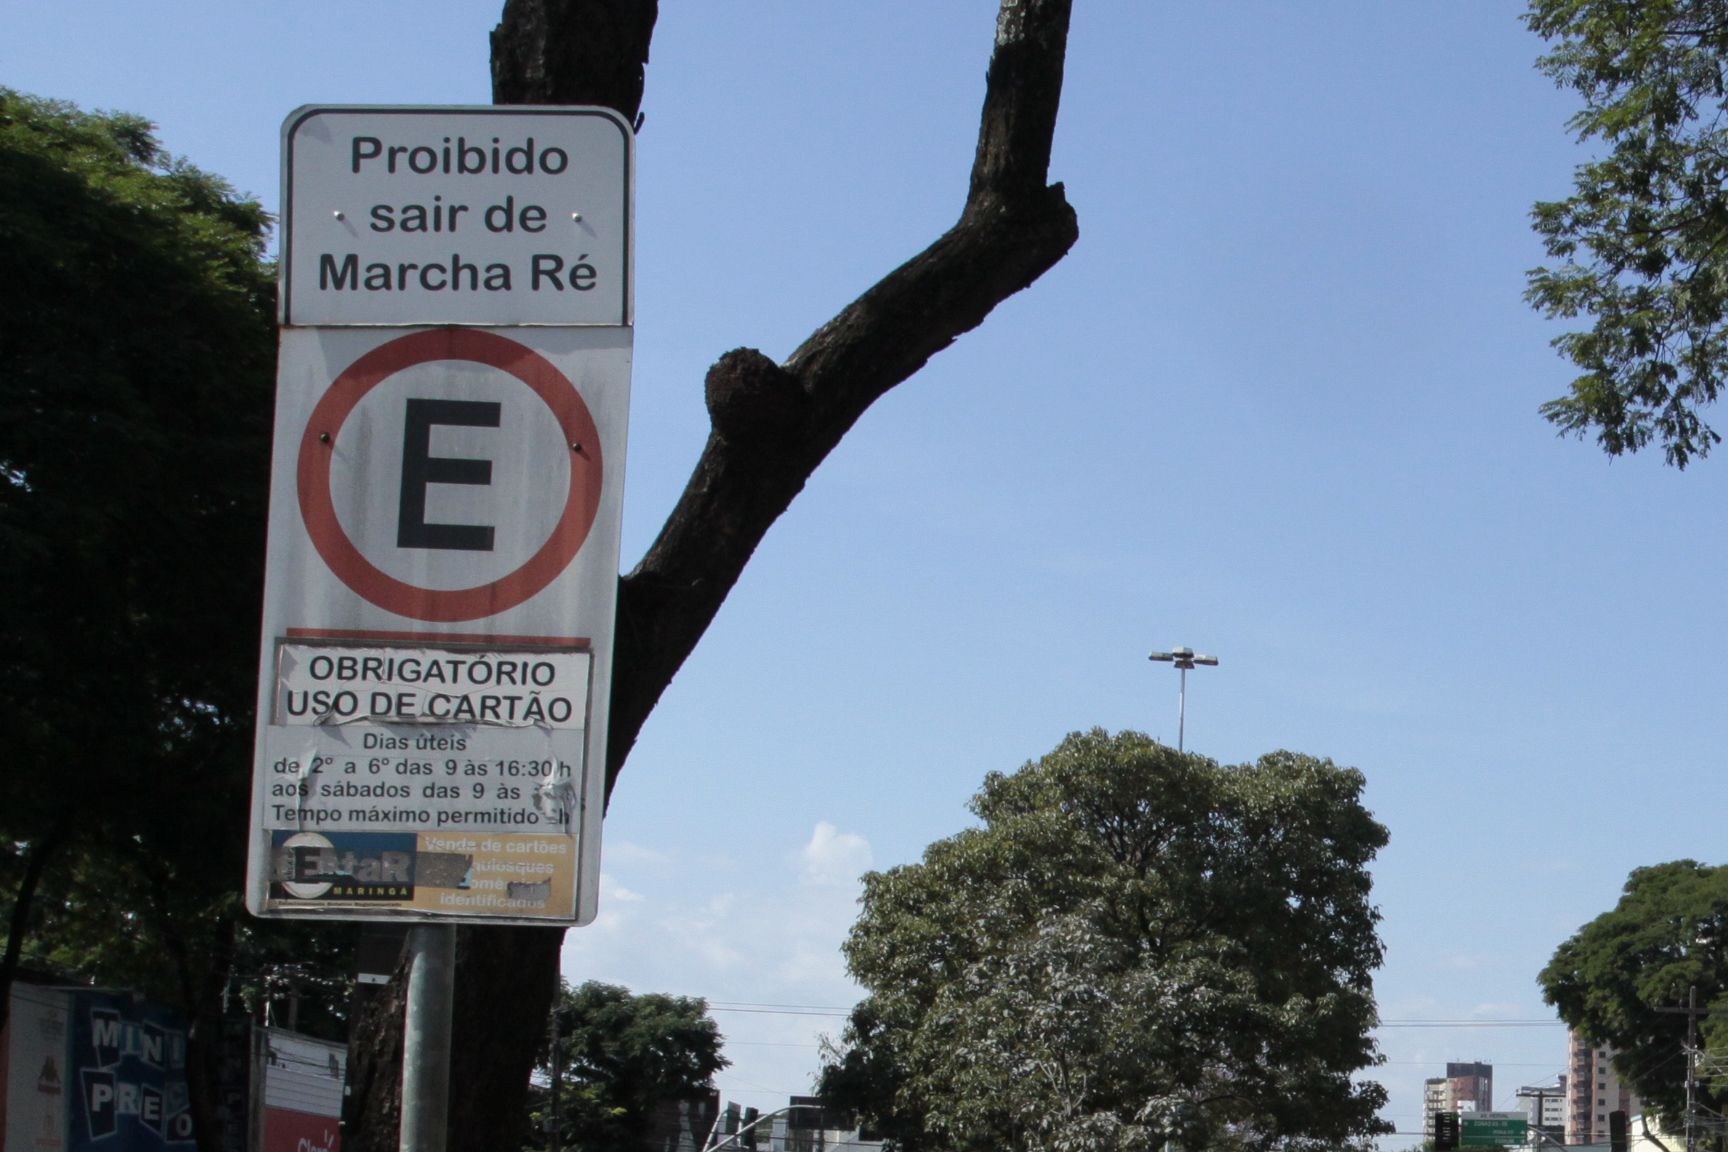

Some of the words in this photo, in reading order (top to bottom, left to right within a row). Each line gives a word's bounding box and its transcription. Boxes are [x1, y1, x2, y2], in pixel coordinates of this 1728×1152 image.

[351, 136, 569, 174] Proibido
[369, 195, 469, 232] sair
[484, 195, 548, 232] de
[318, 253, 512, 291] Marcha
[531, 253, 598, 291] Ré
[397, 398, 502, 552] E
[309, 655, 556, 687] OBRIGATÓRIO
[286, 690, 359, 718] USO
[370, 691, 417, 718] DE
[427, 690, 573, 723] CARTÃO
[363, 732, 409, 750] Dias
[416, 732, 467, 751] úteis
[273, 757, 299, 774] de
[344, 761, 357, 774] a
[395, 757, 433, 776] das
[444, 759, 458, 776] 9
[464, 760, 488, 776] às
[495, 760, 551, 777] 16:30
[271, 784, 309, 797] aos
[320, 781, 411, 798] sábados
[422, 782, 461, 799] das
[472, 782, 485, 799] 9
[496, 783, 521, 800] às
[272, 804, 343, 826] Tempo
[348, 805, 431, 824] máximo
[437, 806, 540, 827] permitido
[481, 838, 501, 852] de
[506, 840, 567, 855] cartões
